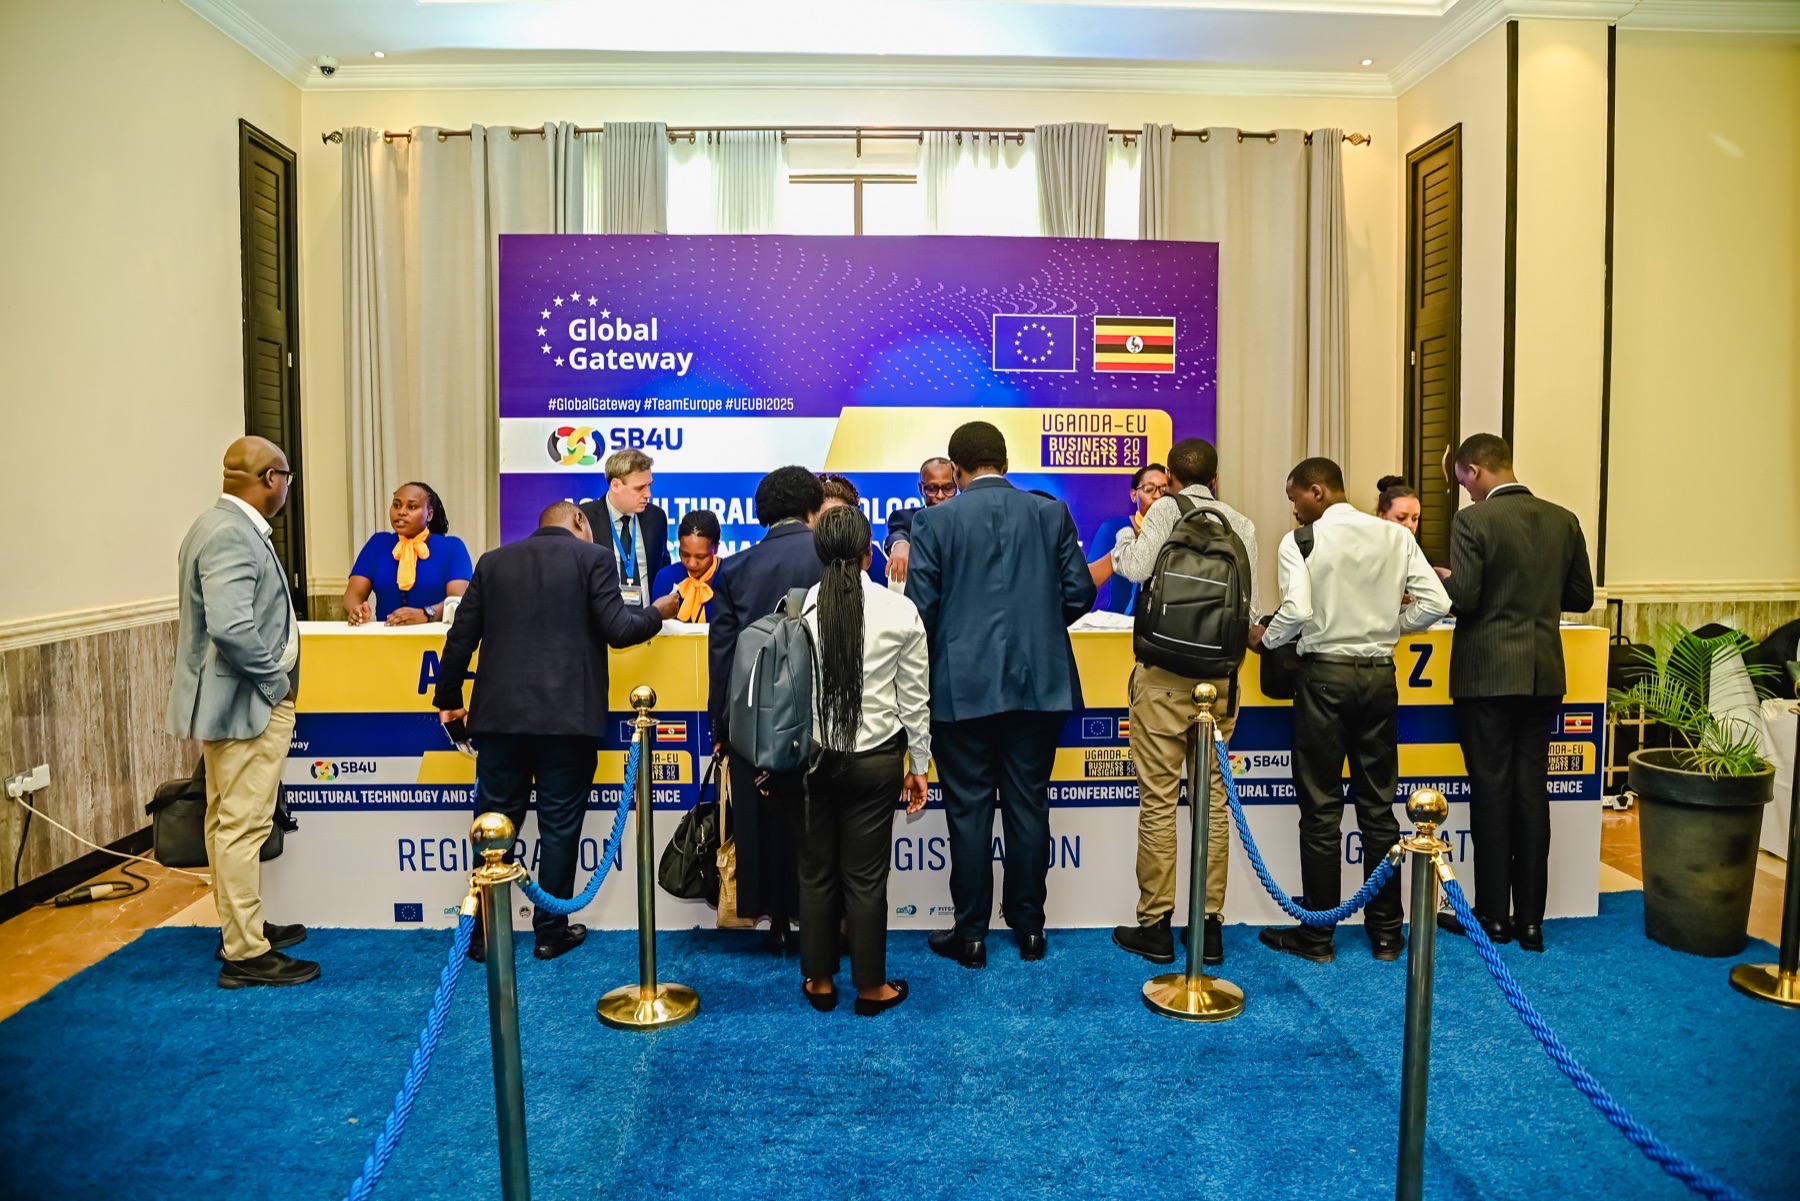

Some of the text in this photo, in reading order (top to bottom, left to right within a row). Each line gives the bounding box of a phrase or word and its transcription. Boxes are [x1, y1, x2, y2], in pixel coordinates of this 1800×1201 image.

[568, 318, 658, 342] Global
[568, 347, 693, 376] Gateway
[548, 397, 794, 413] #GlobalGateway #TeamEurope #UEUBI2025
[609, 427, 683, 451] SB4U
[1048, 437, 1140, 452] BUSINESS 20
[1048, 451, 1140, 466] INSIGHTS 25
[1408, 643, 1433, 688] Z
[340, 761, 377, 773] SB4U
[1088, 761, 1124, 769] BUSINESS
[1253, 755, 1290, 767] SB4U
[1088, 768, 1124, 777] INSIGHTS
[1061, 785, 1140, 800] CONFERENCE
[1546, 780, 1583, 793] RENCE
[285, 790, 360, 804] RICULTURAL
[360, 789, 439, 804] TECHNOLOGY
[442, 789, 467, 803] AND
